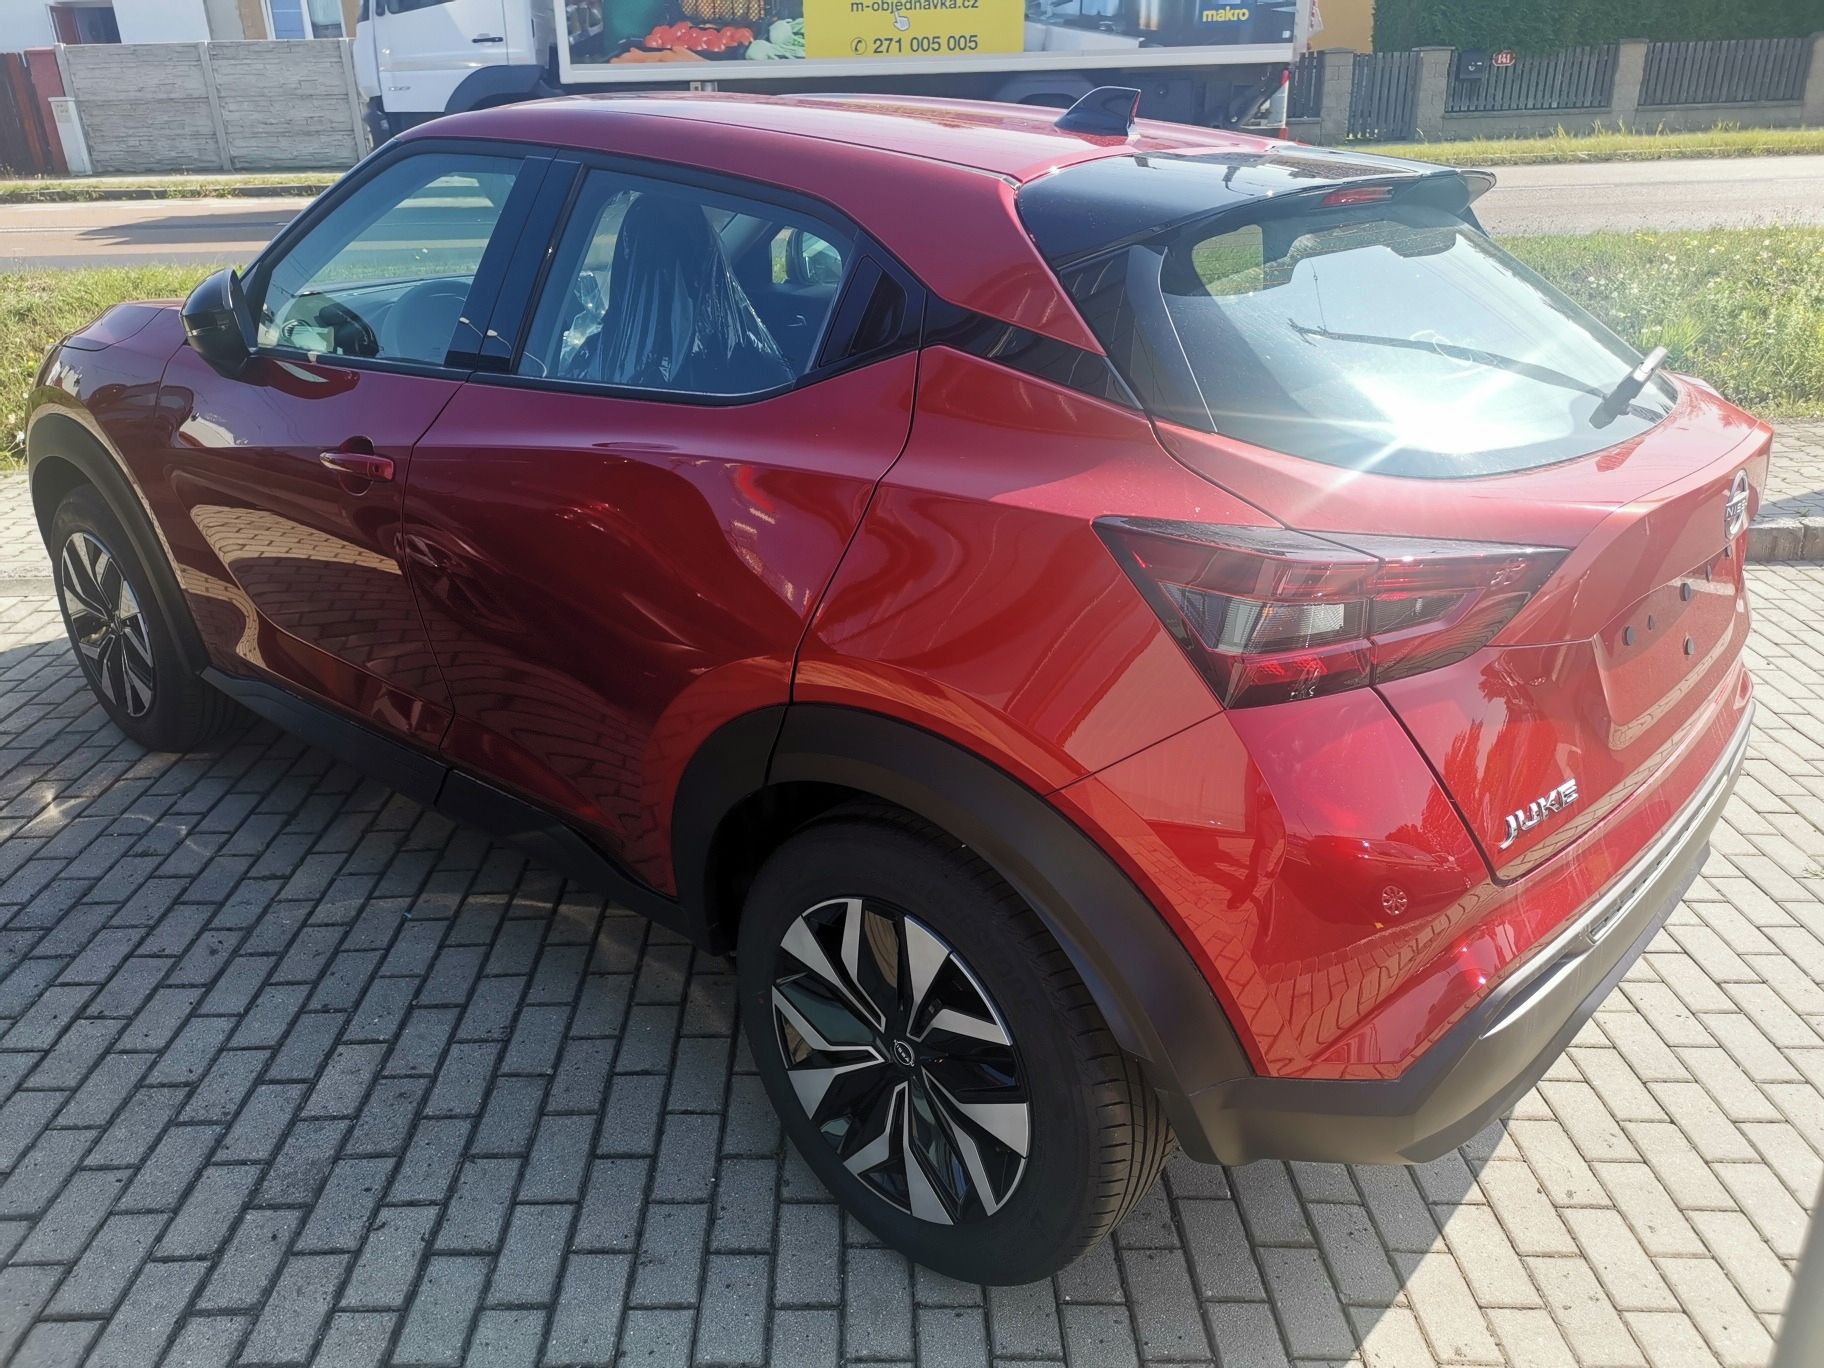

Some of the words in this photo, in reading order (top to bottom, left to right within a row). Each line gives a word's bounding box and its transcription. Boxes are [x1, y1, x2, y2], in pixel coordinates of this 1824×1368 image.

[1203, 6, 1249, 22] makro
[873, 38, 902, 53] 271
[910, 37, 941, 52] 005
[947, 35, 978, 51] 005
[1500, 779, 1579, 850] JUKE
